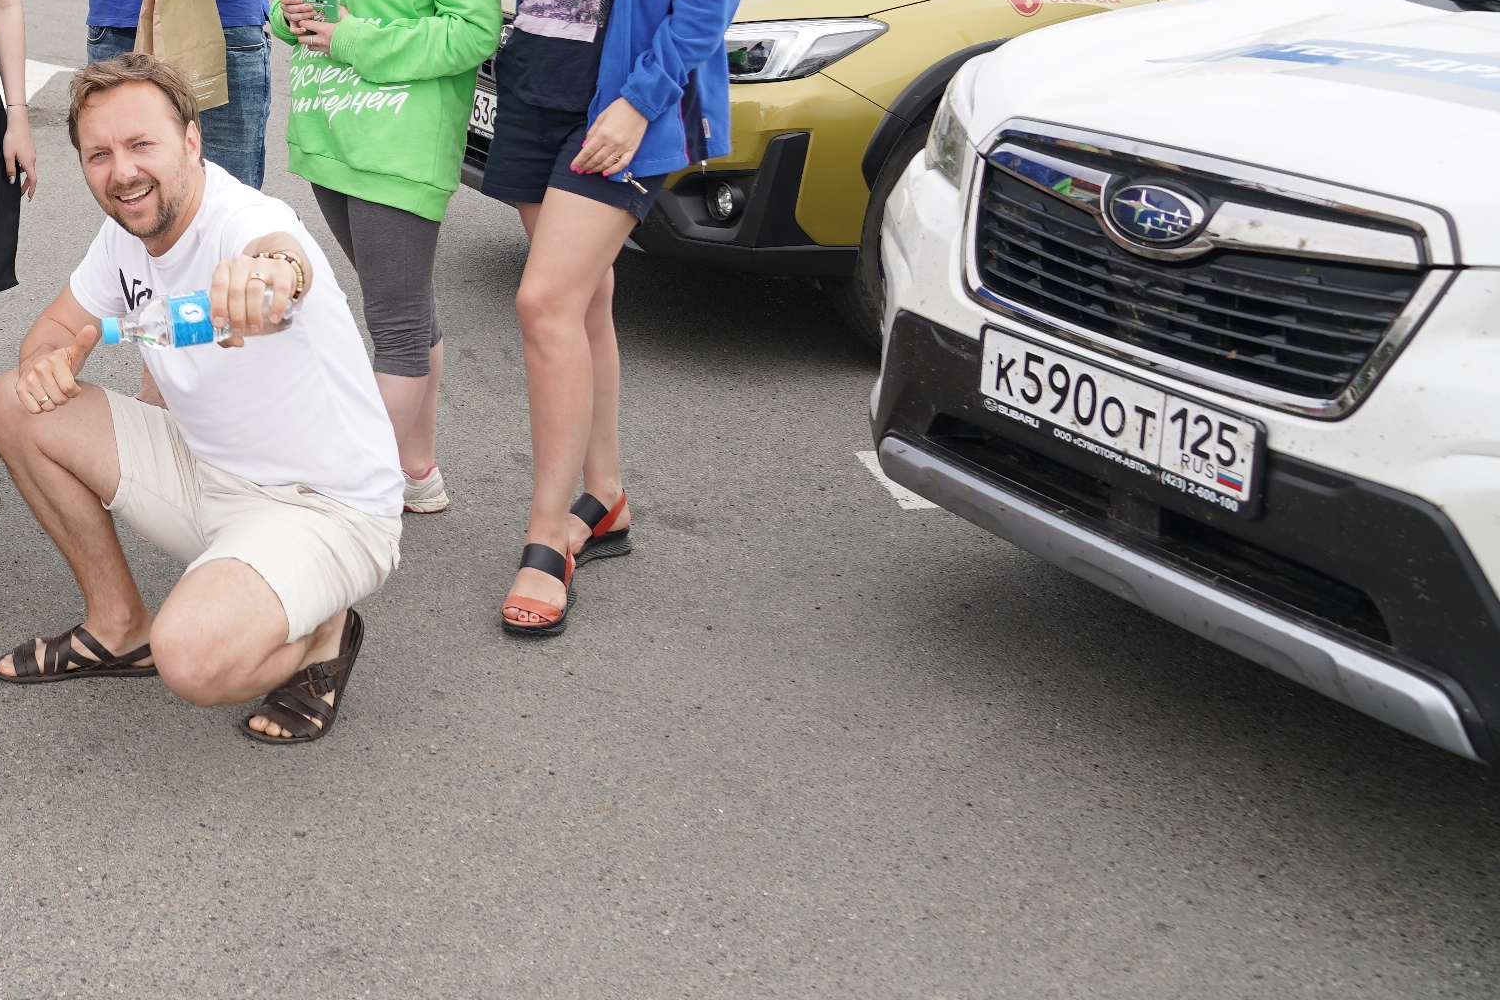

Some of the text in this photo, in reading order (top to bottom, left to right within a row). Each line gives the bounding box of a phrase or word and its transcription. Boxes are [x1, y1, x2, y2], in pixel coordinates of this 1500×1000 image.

[1278, 43, 1500, 79] ТЕСТ-ДР
[997, 404, 1040, 429] SUBARU
[1169, 407, 1236, 467] 125
[1053, 427, 1072, 443] ООО
[1160, 470, 1187, 494] (423)
[1180, 453, 1215, 480] RUS
